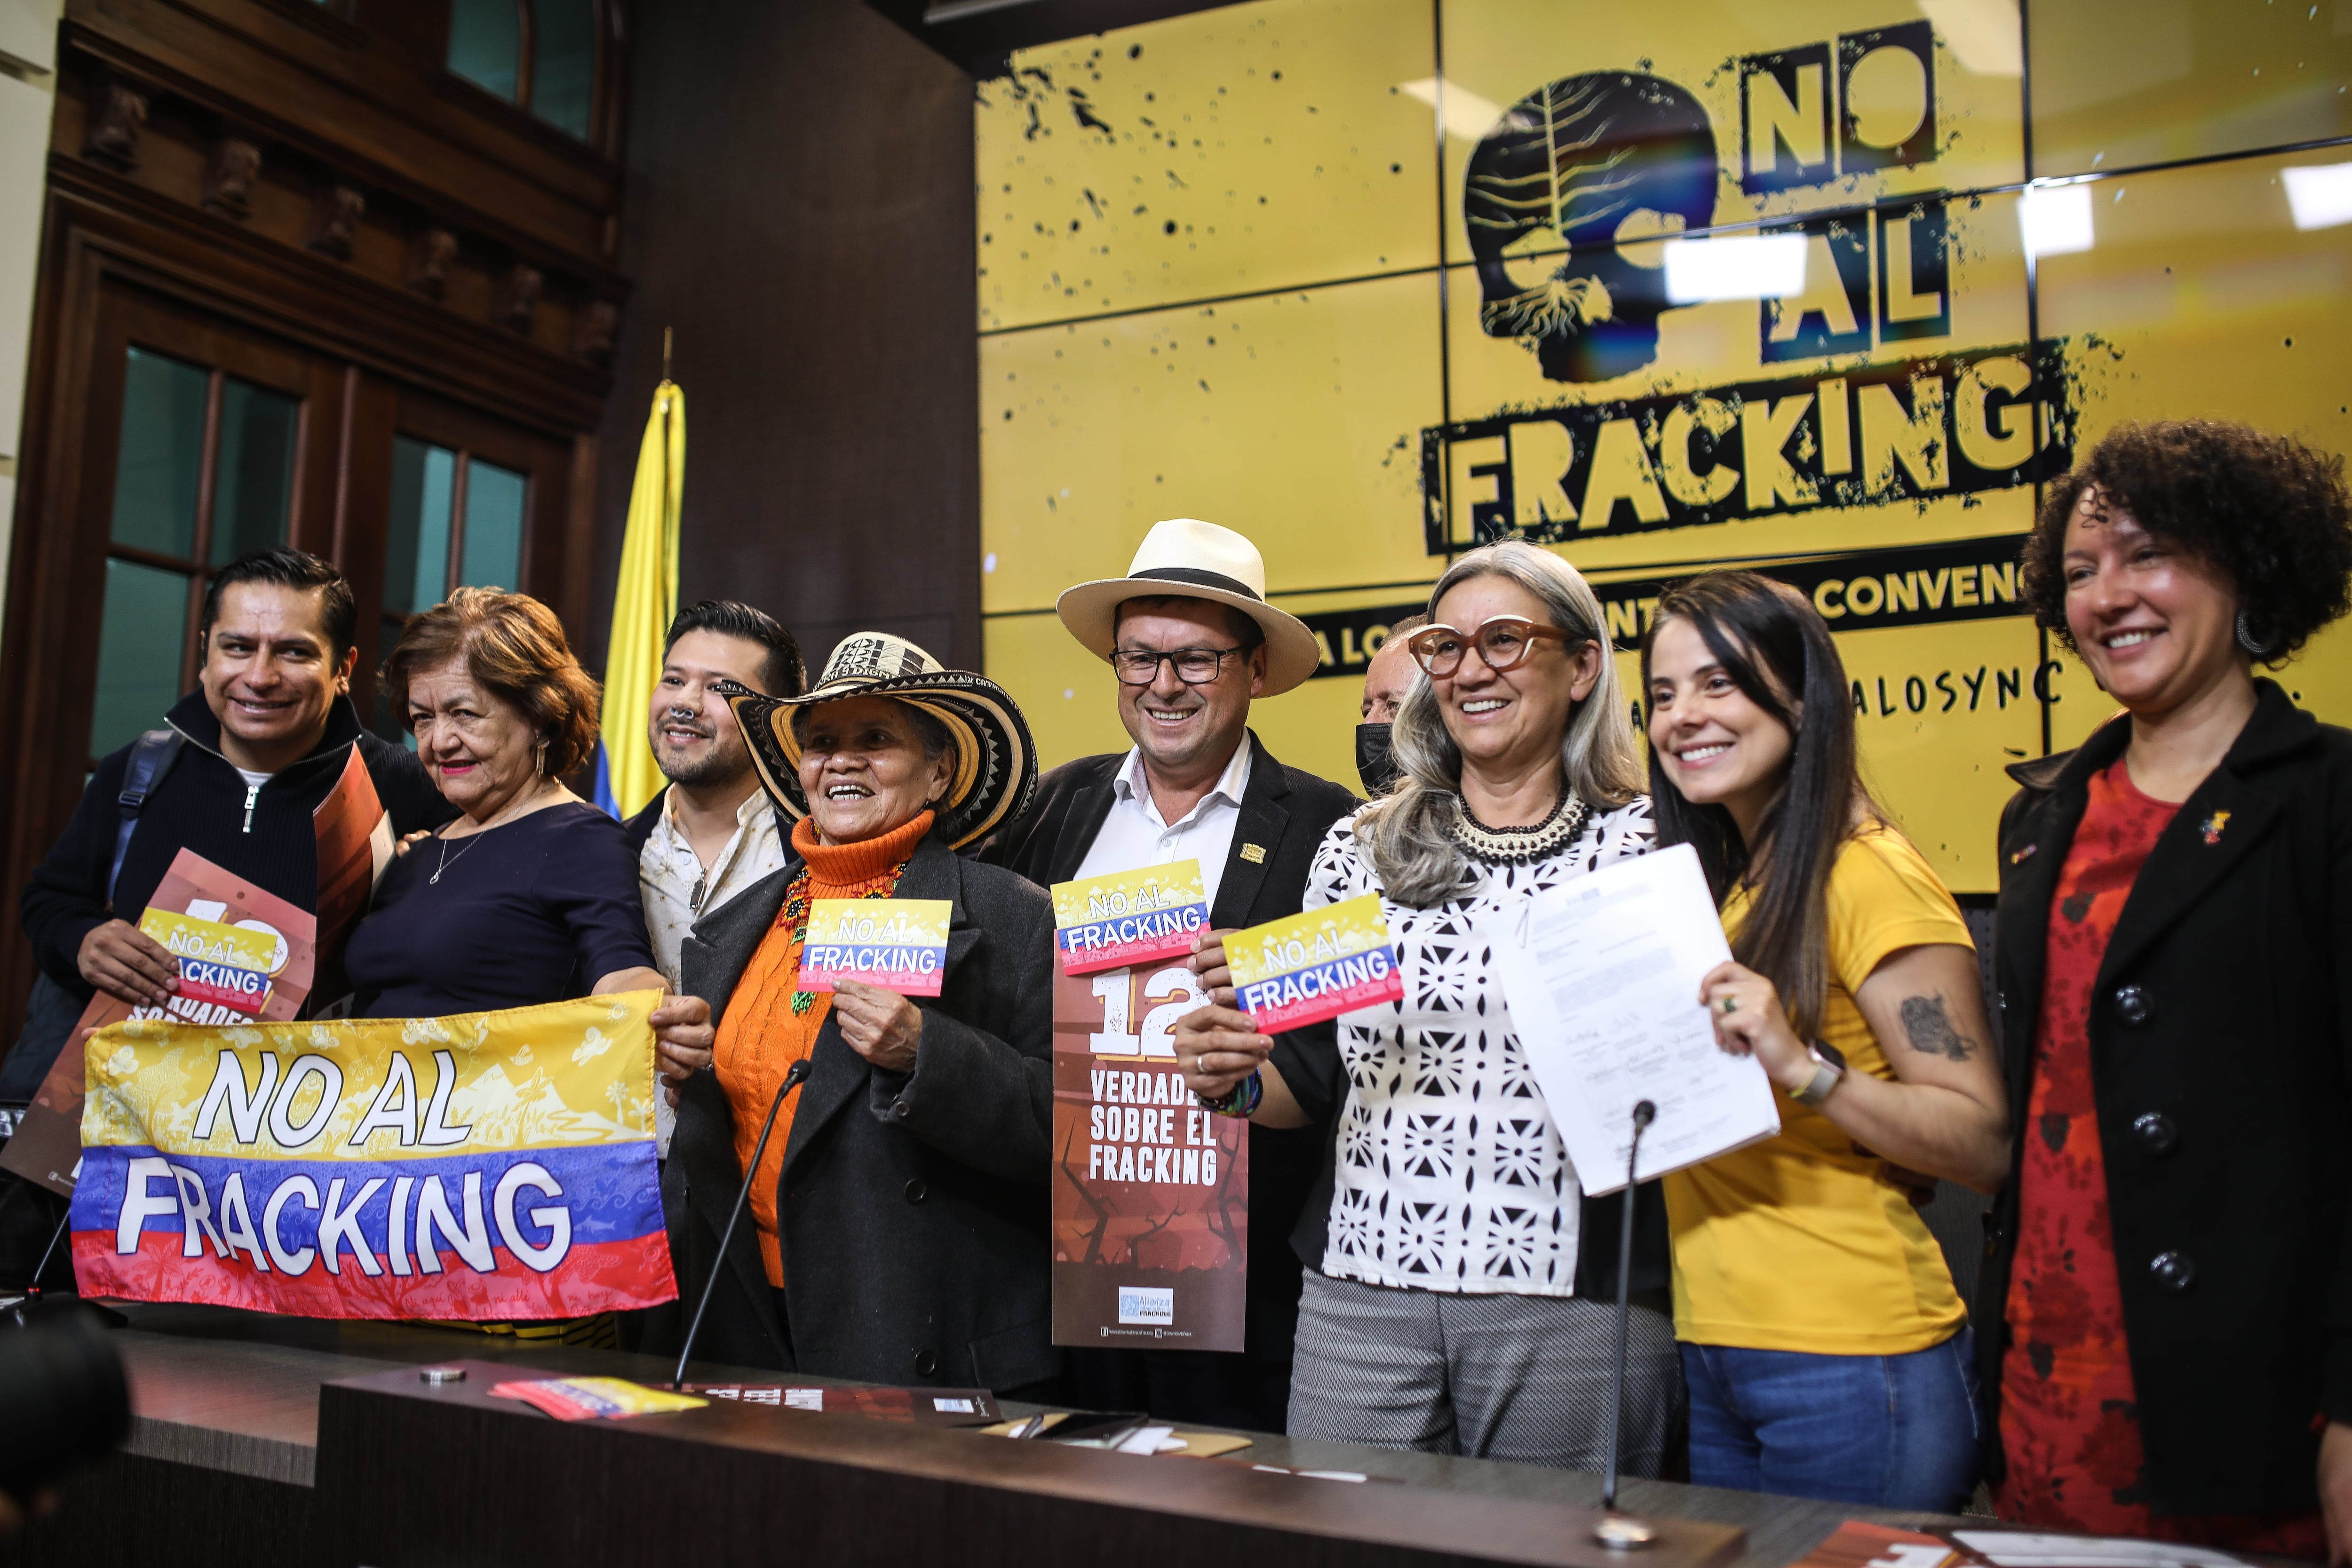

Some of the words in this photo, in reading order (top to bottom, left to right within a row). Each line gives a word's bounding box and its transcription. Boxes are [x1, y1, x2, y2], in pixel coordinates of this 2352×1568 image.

[1748, 45, 1927, 175] NO
[1768, 217, 1942, 343] AL
[1439, 356, 2048, 544] FRACKING
[1814, 561, 2026, 619] CONVEN
[1341, 624, 1388, 665] LO
[1088, 891, 1128, 920] NO
[1136, 884, 1170, 912] AL
[167, 931, 205, 956] NO
[207, 940, 239, 965] AL
[837, 917, 875, 942] NO
[878, 917, 914, 943] AL
[1066, 906, 1201, 955] FRACKING
[1263, 939, 1306, 974] NO
[1315, 928, 1353, 962] AL
[177, 957, 259, 995] CKING
[807, 946, 938, 975] FRACKING
[1243, 950, 1390, 1016] FRACKING
[1089, 966, 1213, 1058] 12
[192, 1049, 345, 1148] NO
[347, 1048, 474, 1146] AL
[1090, 1105, 1174, 1145] SOBRE
[1186, 1107, 1217, 1147] EL
[1089, 1144, 1217, 1186] FRACKING
[116, 1156, 572, 1277] FRACKING
